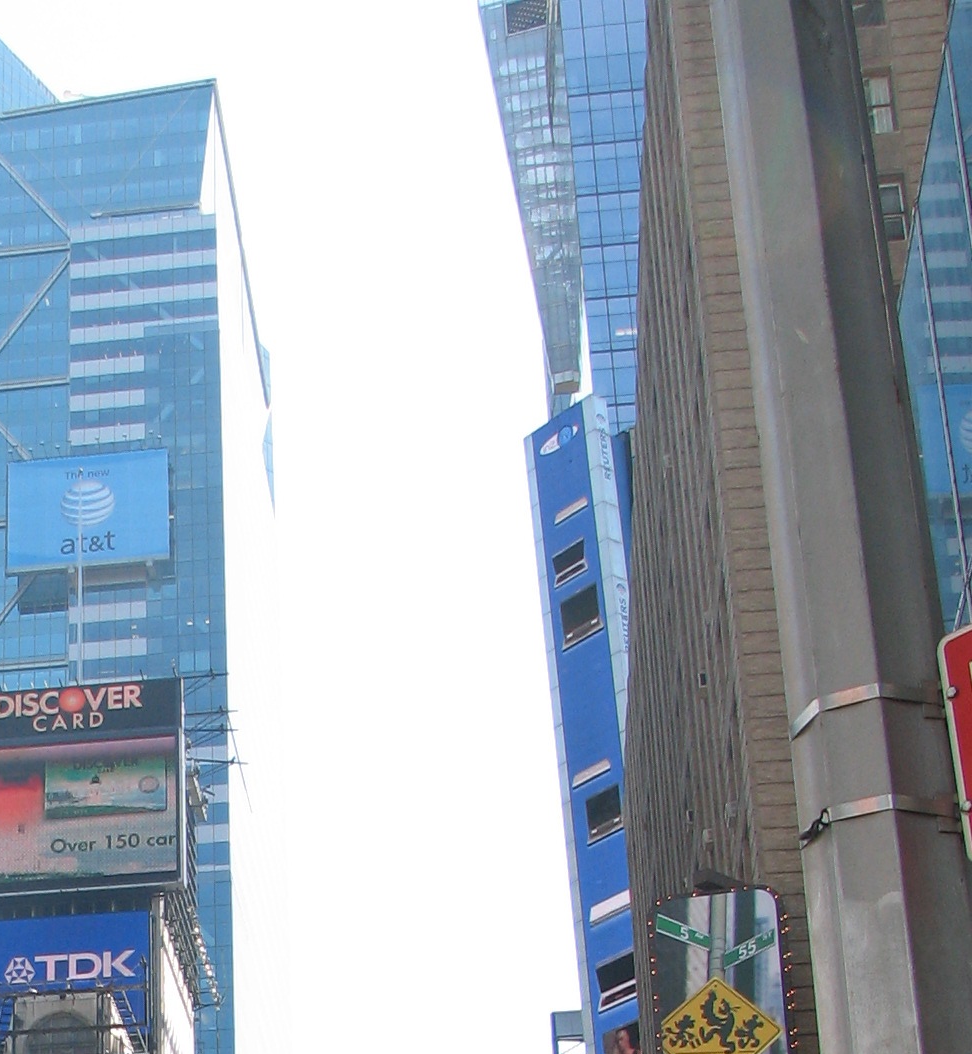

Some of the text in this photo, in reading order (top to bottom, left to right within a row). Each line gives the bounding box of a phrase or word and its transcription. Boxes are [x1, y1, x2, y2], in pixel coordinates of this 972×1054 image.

[87, 468, 110, 478] new
[61, 531, 116, 554] at&t
[32, 712, 104, 733] CARD
[51, 833, 176, 853] Over 150 car
[680, 927, 689, 940] 5
[738, 940, 757, 960] 55
[35, 950, 136, 981] TDK
